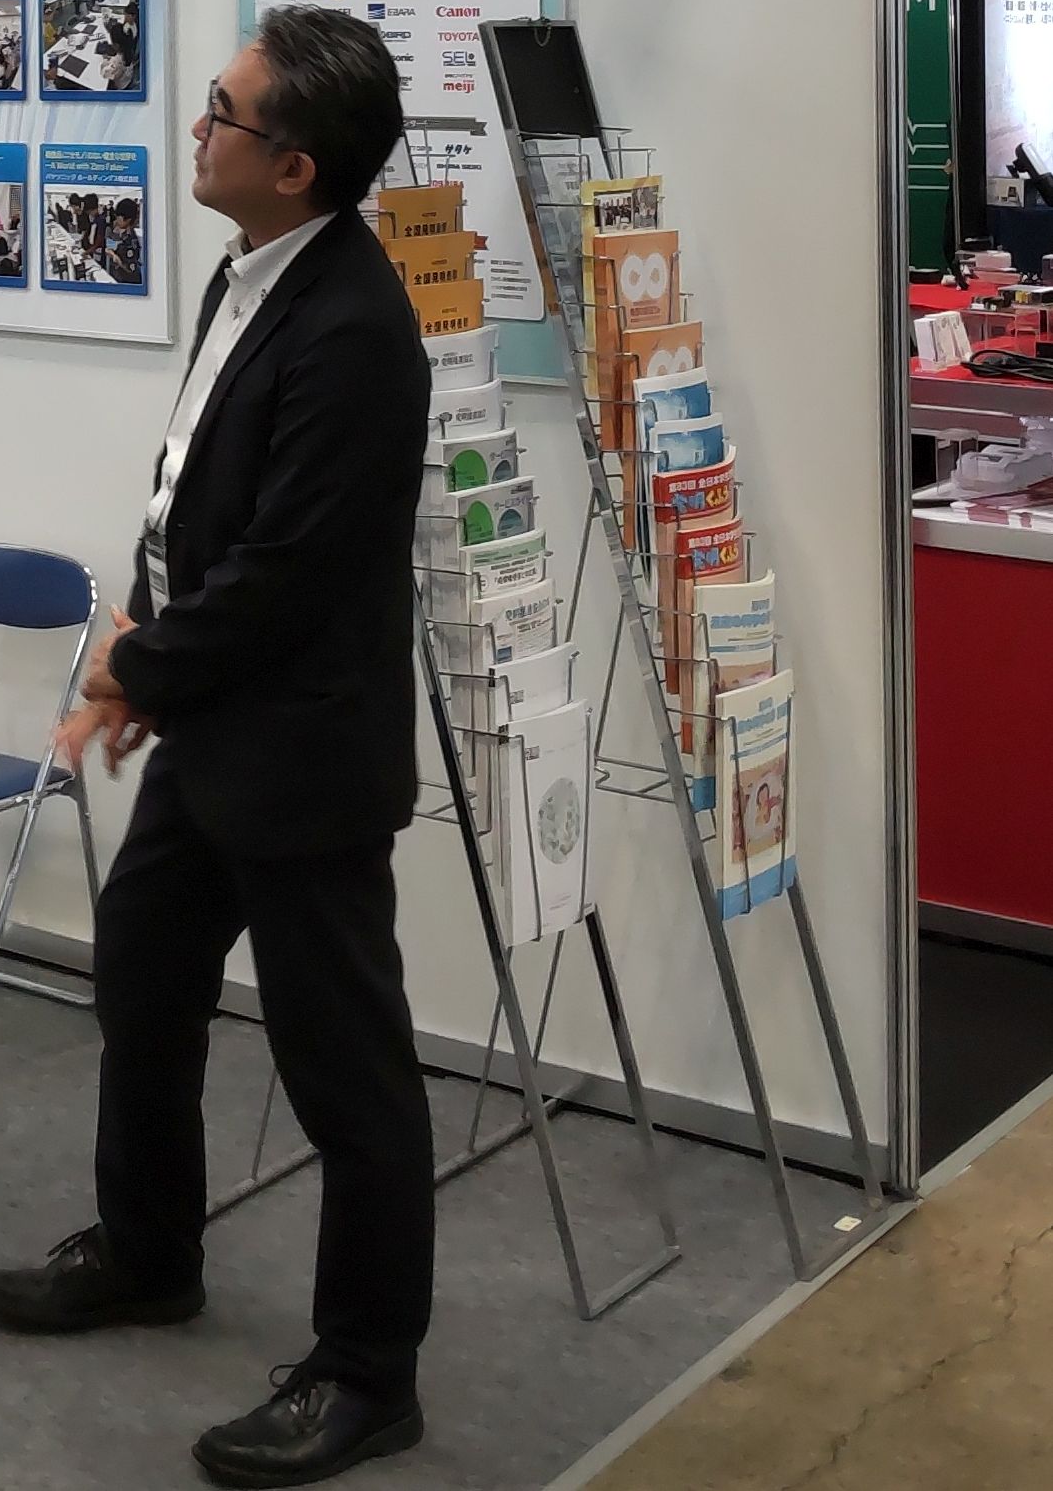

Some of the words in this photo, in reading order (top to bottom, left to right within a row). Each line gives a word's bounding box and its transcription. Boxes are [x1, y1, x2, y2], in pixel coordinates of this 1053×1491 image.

[387, 8, 416, 17] EBARA
[436, 5, 480, 18] Canon
[438, 31, 480, 42] TOYOTA
[443, 80, 475, 94] meiji
